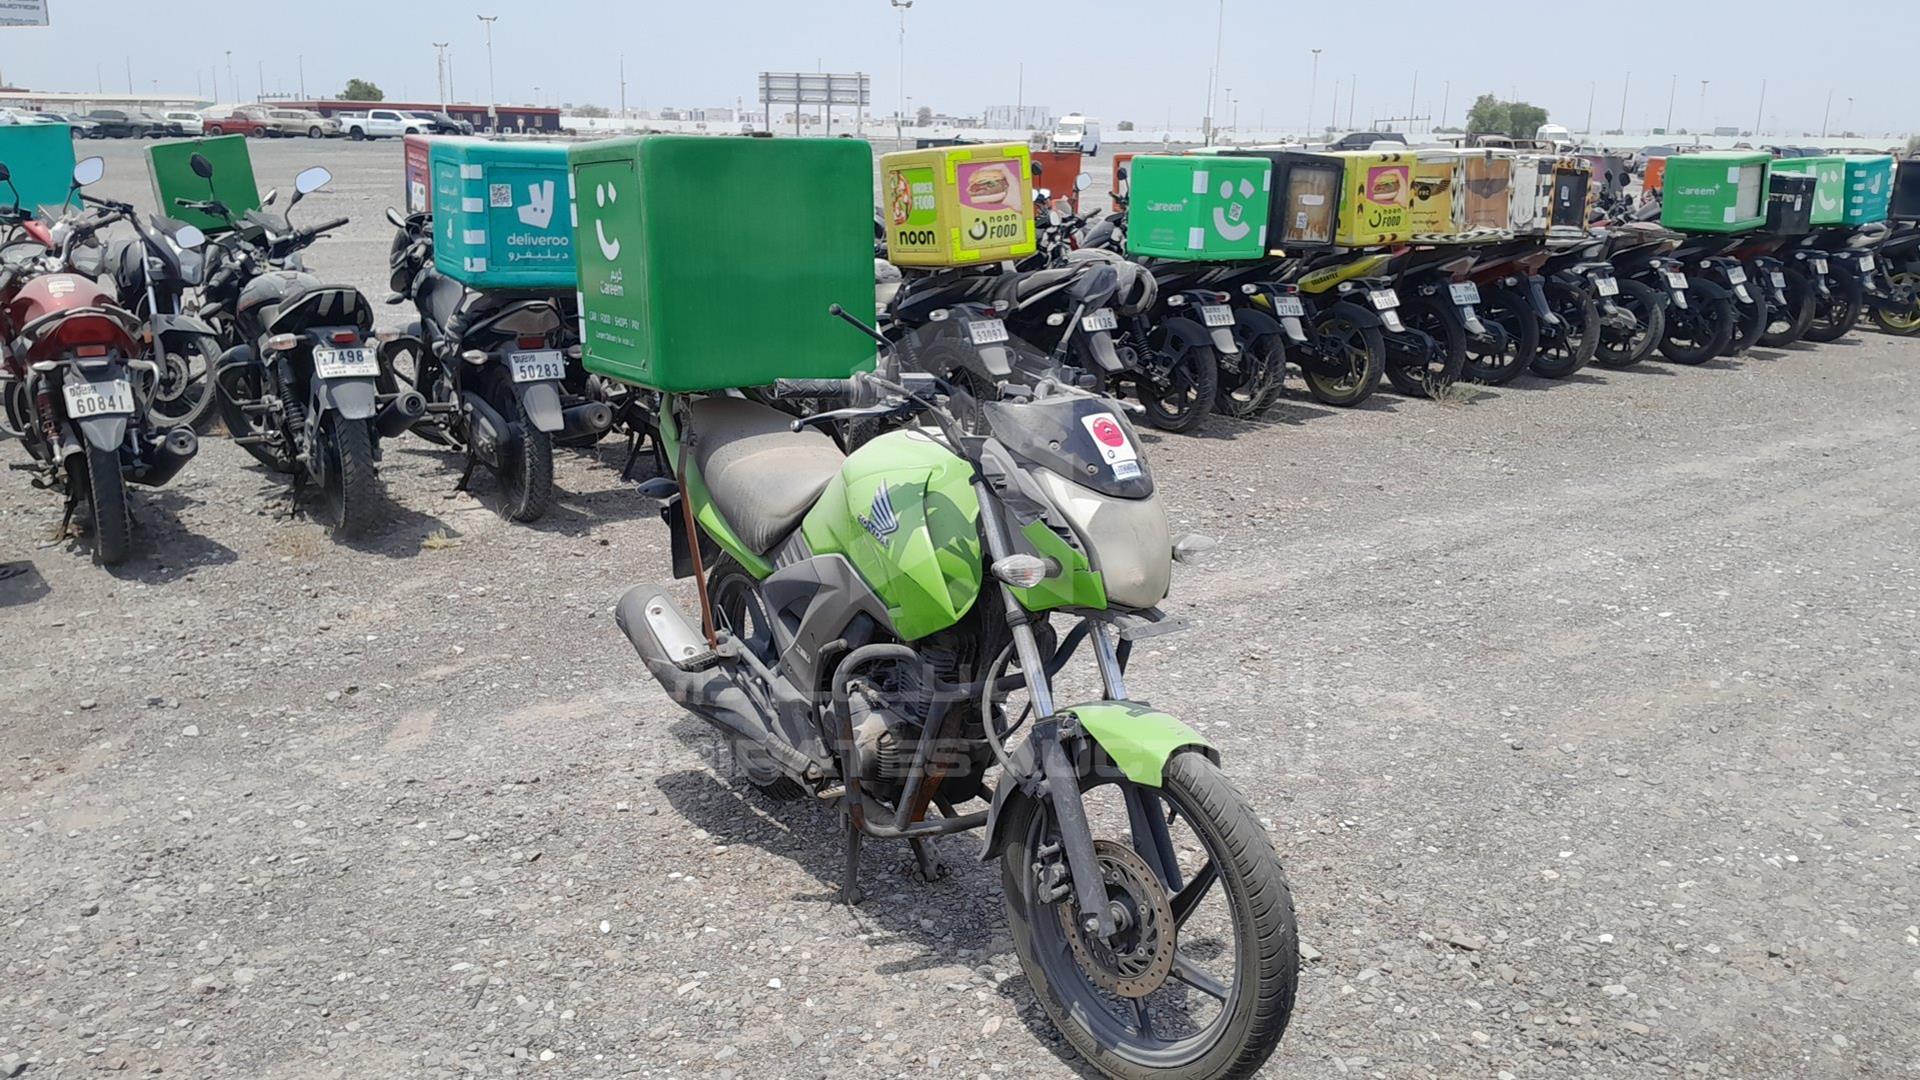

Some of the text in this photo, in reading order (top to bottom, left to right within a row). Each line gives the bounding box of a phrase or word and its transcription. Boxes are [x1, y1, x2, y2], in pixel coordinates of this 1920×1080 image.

[913, 194, 935, 210] FOOD
[989, 213, 1017, 223] noon
[1382, 215, 1401, 227] FOOD
[899, 230, 936, 246] noon
[990, 223, 1017, 239] FOOD
[507, 233, 569, 246] deliveroo
[600, 280, 624, 297] Careem
[328, 350, 364, 364] 7498
[519, 363, 559, 379] 50283
[76, 395, 124, 414] 60841
